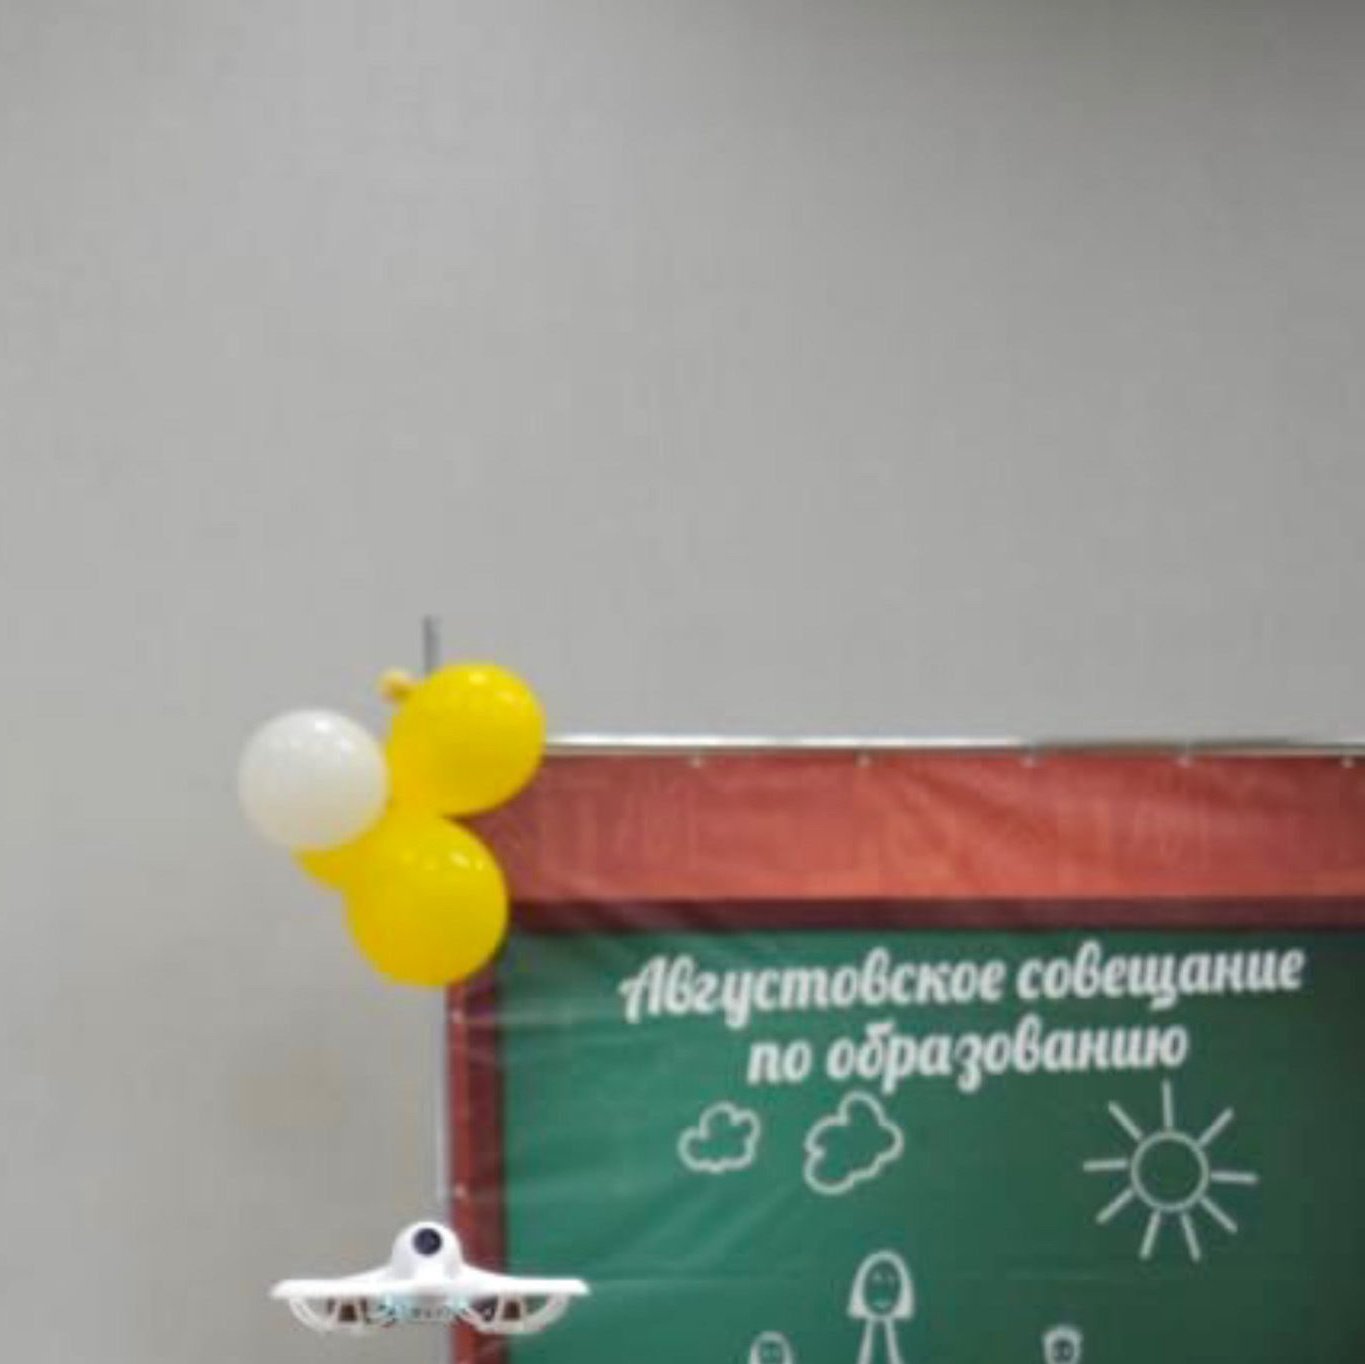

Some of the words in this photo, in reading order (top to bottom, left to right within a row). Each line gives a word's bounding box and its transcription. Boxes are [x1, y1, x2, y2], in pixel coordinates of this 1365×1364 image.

[619, 947, 1006, 1029] Августовское
[1016, 940, 1306, 1010] совещание
[747, 1036, 812, 1085] по
[826, 1014, 1189, 1093] образованию
